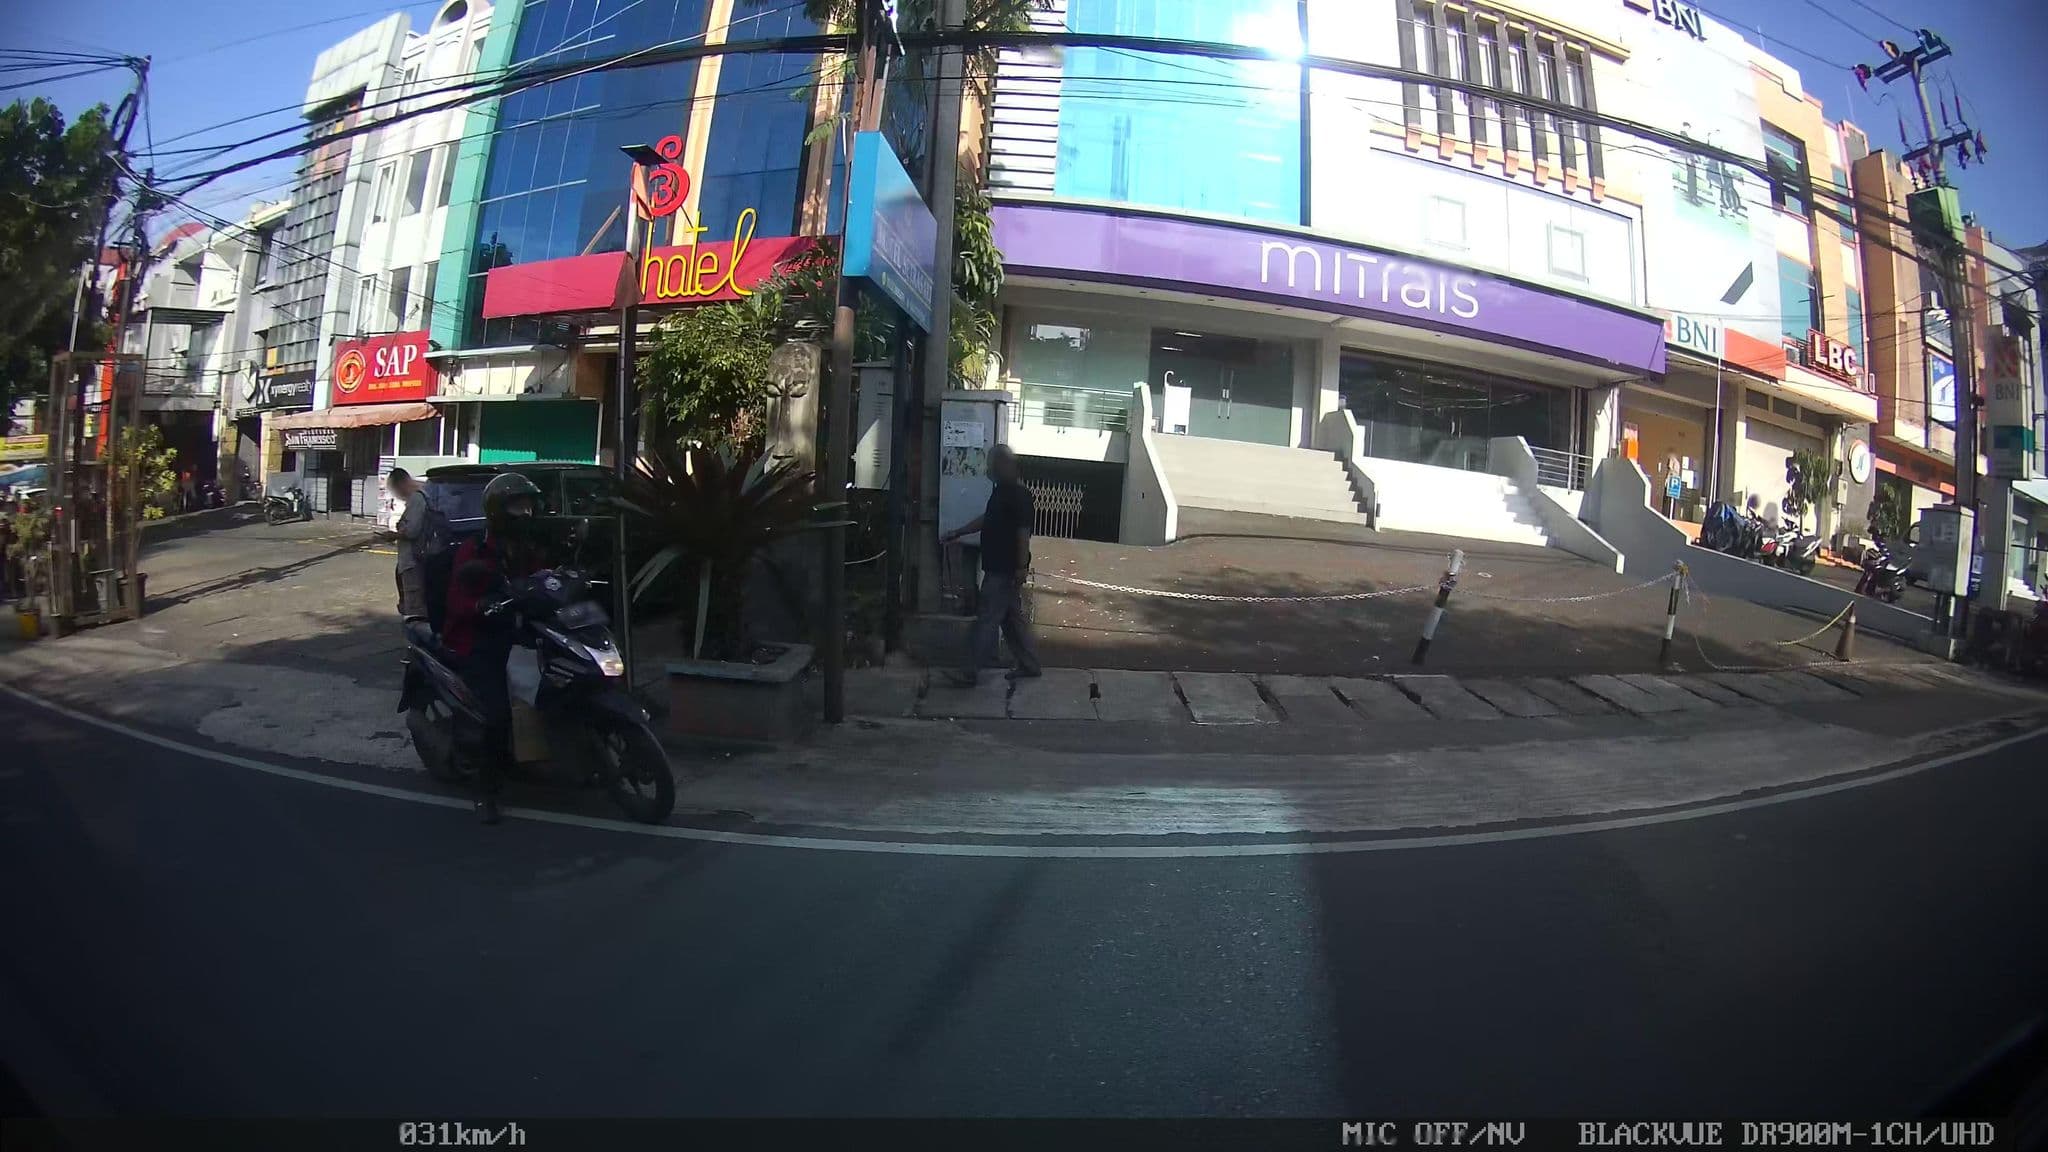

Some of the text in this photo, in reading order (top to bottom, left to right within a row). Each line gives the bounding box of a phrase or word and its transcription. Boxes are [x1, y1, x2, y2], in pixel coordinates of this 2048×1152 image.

[641, 208, 757, 298] hotel
[1677, 316, 1716, 352] BNI
[374, 344, 417, 378] SAP
